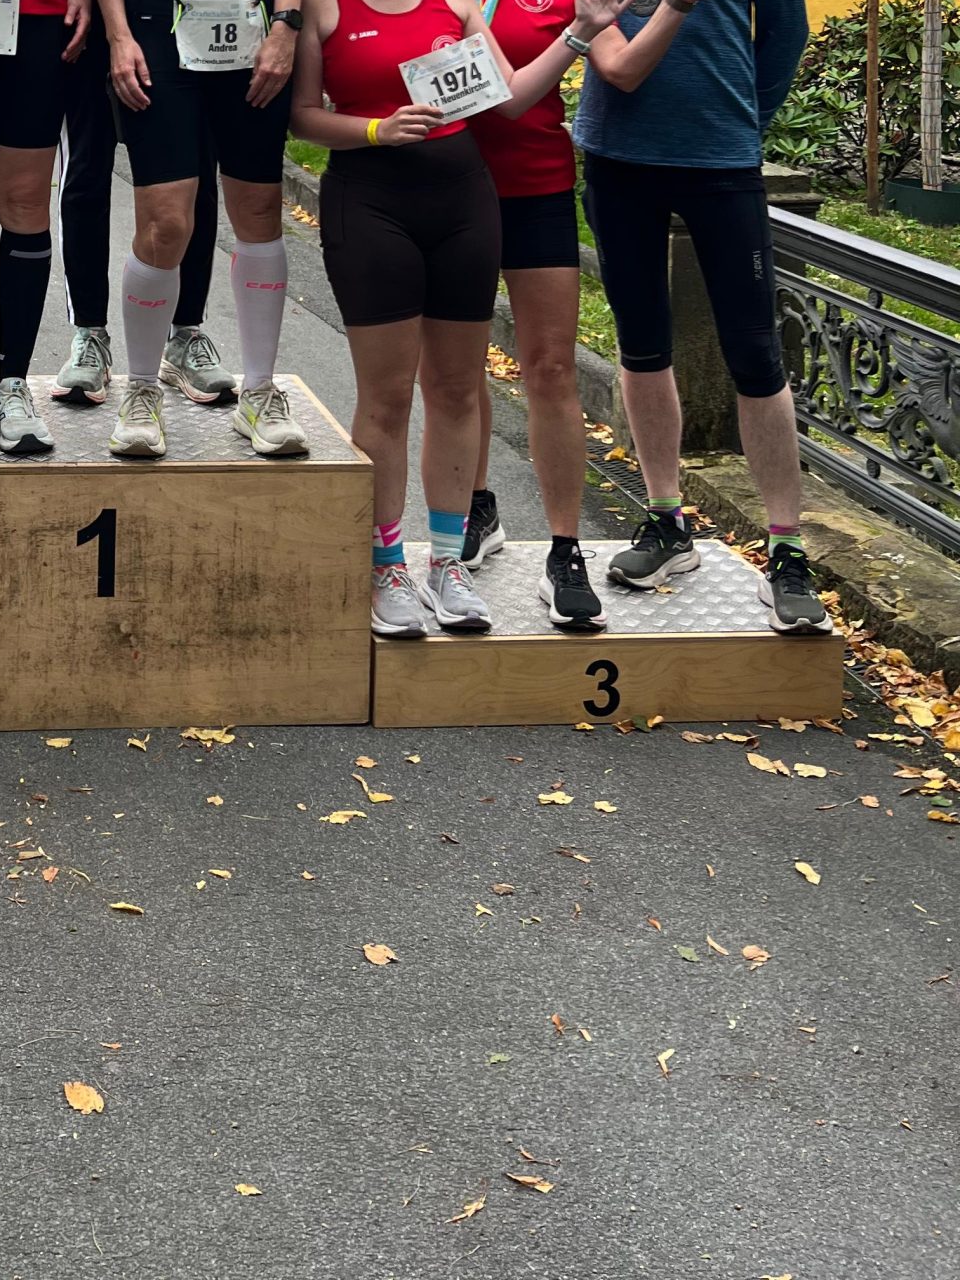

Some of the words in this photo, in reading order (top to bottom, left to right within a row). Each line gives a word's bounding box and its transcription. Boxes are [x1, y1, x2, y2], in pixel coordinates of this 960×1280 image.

[211, 23, 238, 44] 18
[208, 43, 238, 53] Andrea
[430, 62, 483, 97] 1974
[440, 80, 491, 106] Neuenkirchen
[245, 282, 287, 291] cep
[127, 294, 167, 308] cep
[76, 508, 117, 598] 1
[583, 659, 621, 716] 3
